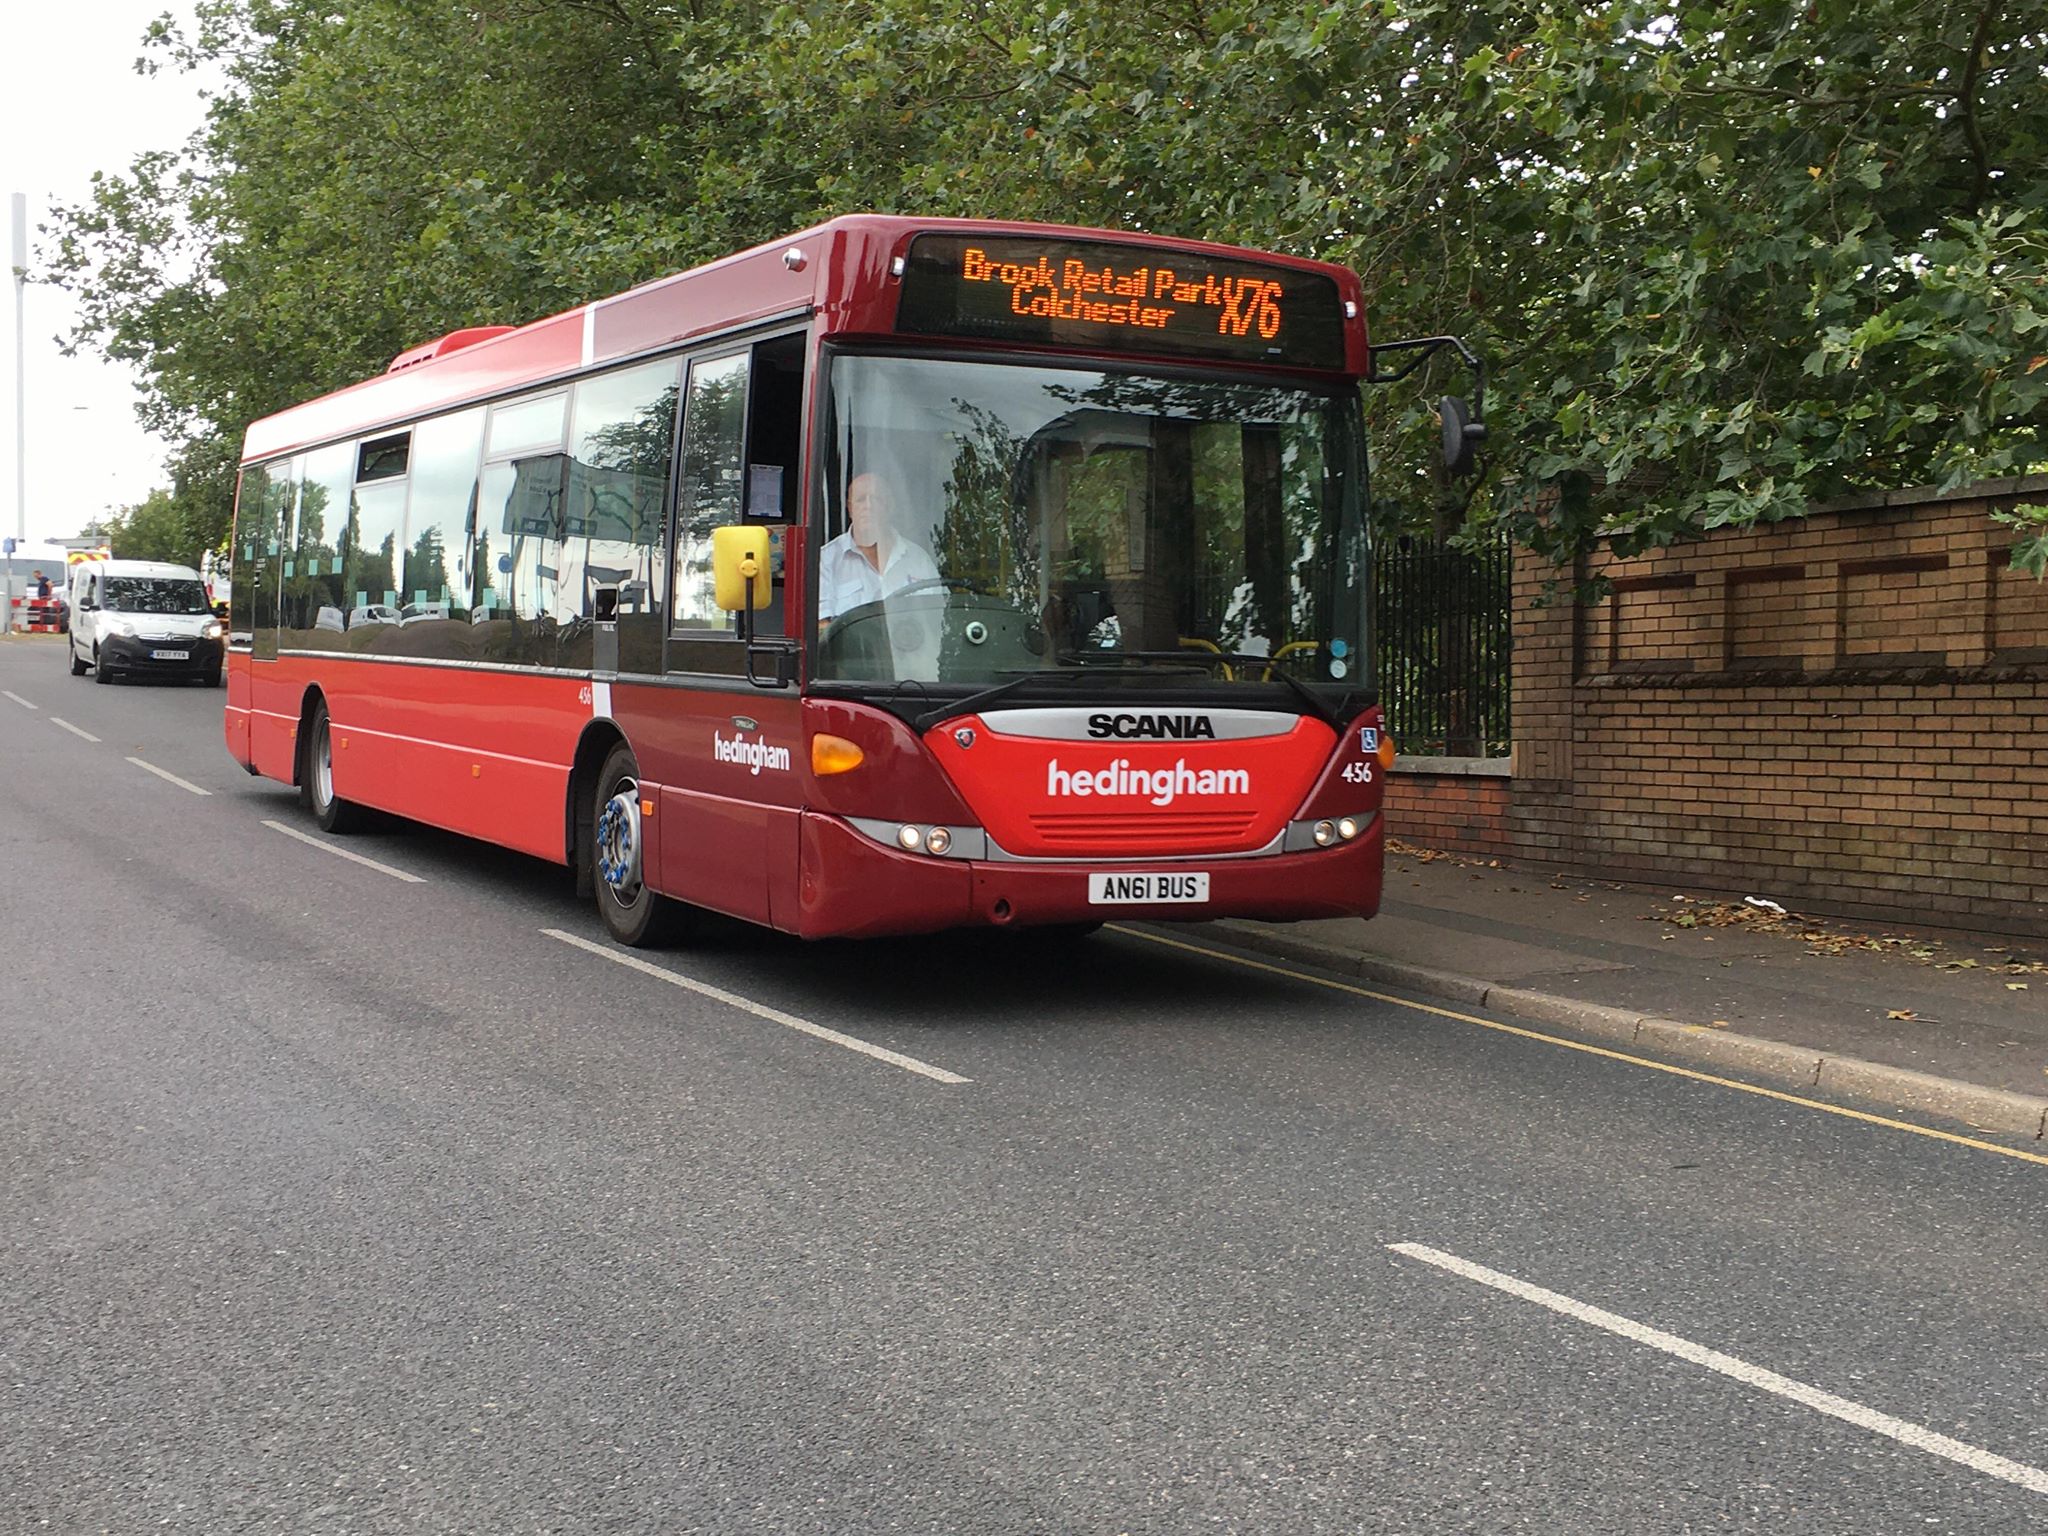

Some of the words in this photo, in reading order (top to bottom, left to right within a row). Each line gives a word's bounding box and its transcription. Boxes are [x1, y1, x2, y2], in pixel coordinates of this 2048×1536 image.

[963, 248, 1056, 287] Brook
[1063, 259, 1149, 297] Retail
[1153, 269, 1222, 305] Park
[1011, 283, 1176, 328] Colchester
[1218, 277, 1283, 339] X76
[578, 686, 592, 705] 456
[1087, 713, 1216, 739] SCANIA
[713, 730, 790, 776] hedingham
[1341, 762, 1373, 783] 456
[1047, 758, 1249, 806] hedingham
[1103, 877, 1151, 900] AN61
[1157, 876, 1197, 899] BUS
